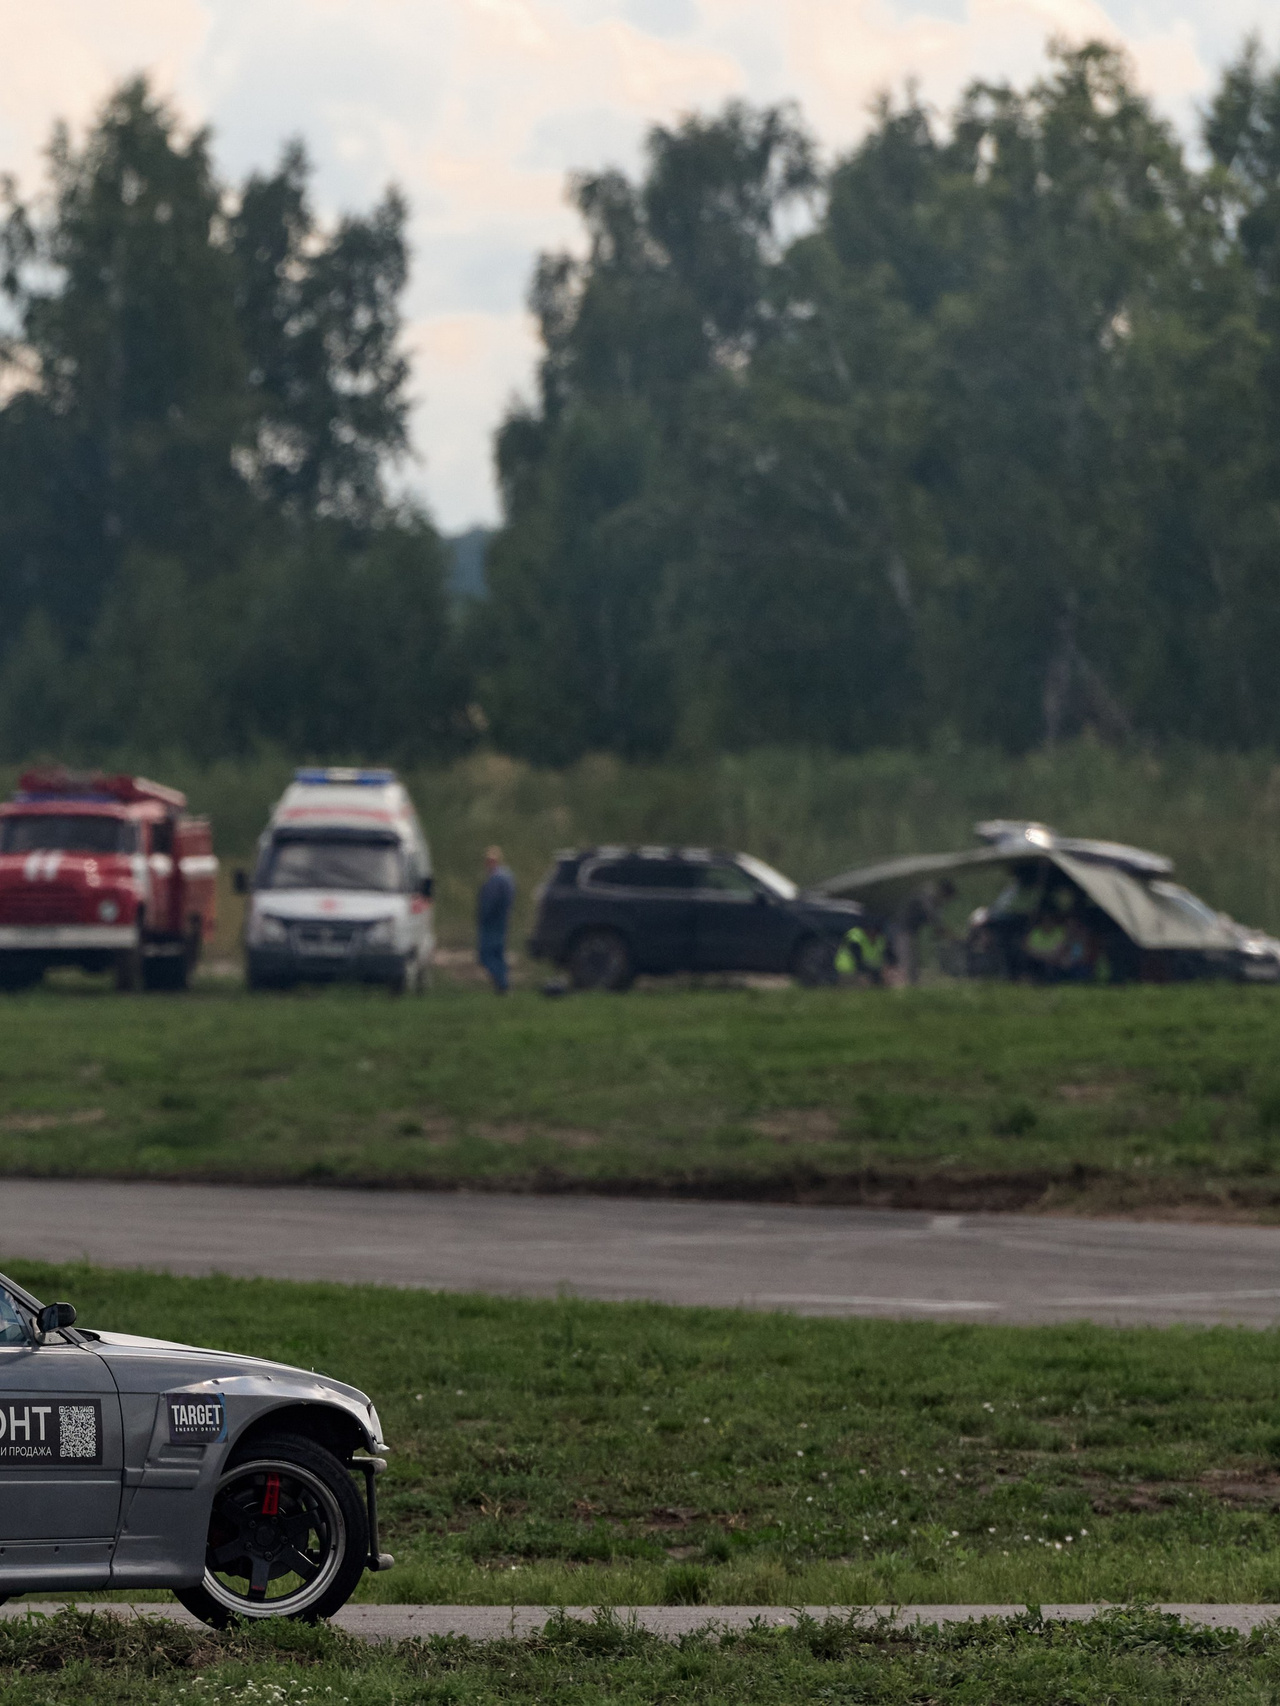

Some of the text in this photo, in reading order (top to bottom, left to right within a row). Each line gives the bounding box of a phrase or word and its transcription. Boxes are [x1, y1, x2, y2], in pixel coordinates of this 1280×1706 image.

[171, 1404, 221, 1425] TARGET
[0, 1447, 7, 1456] И
[9, 1446, 52, 1457] ПРОДАЖА
